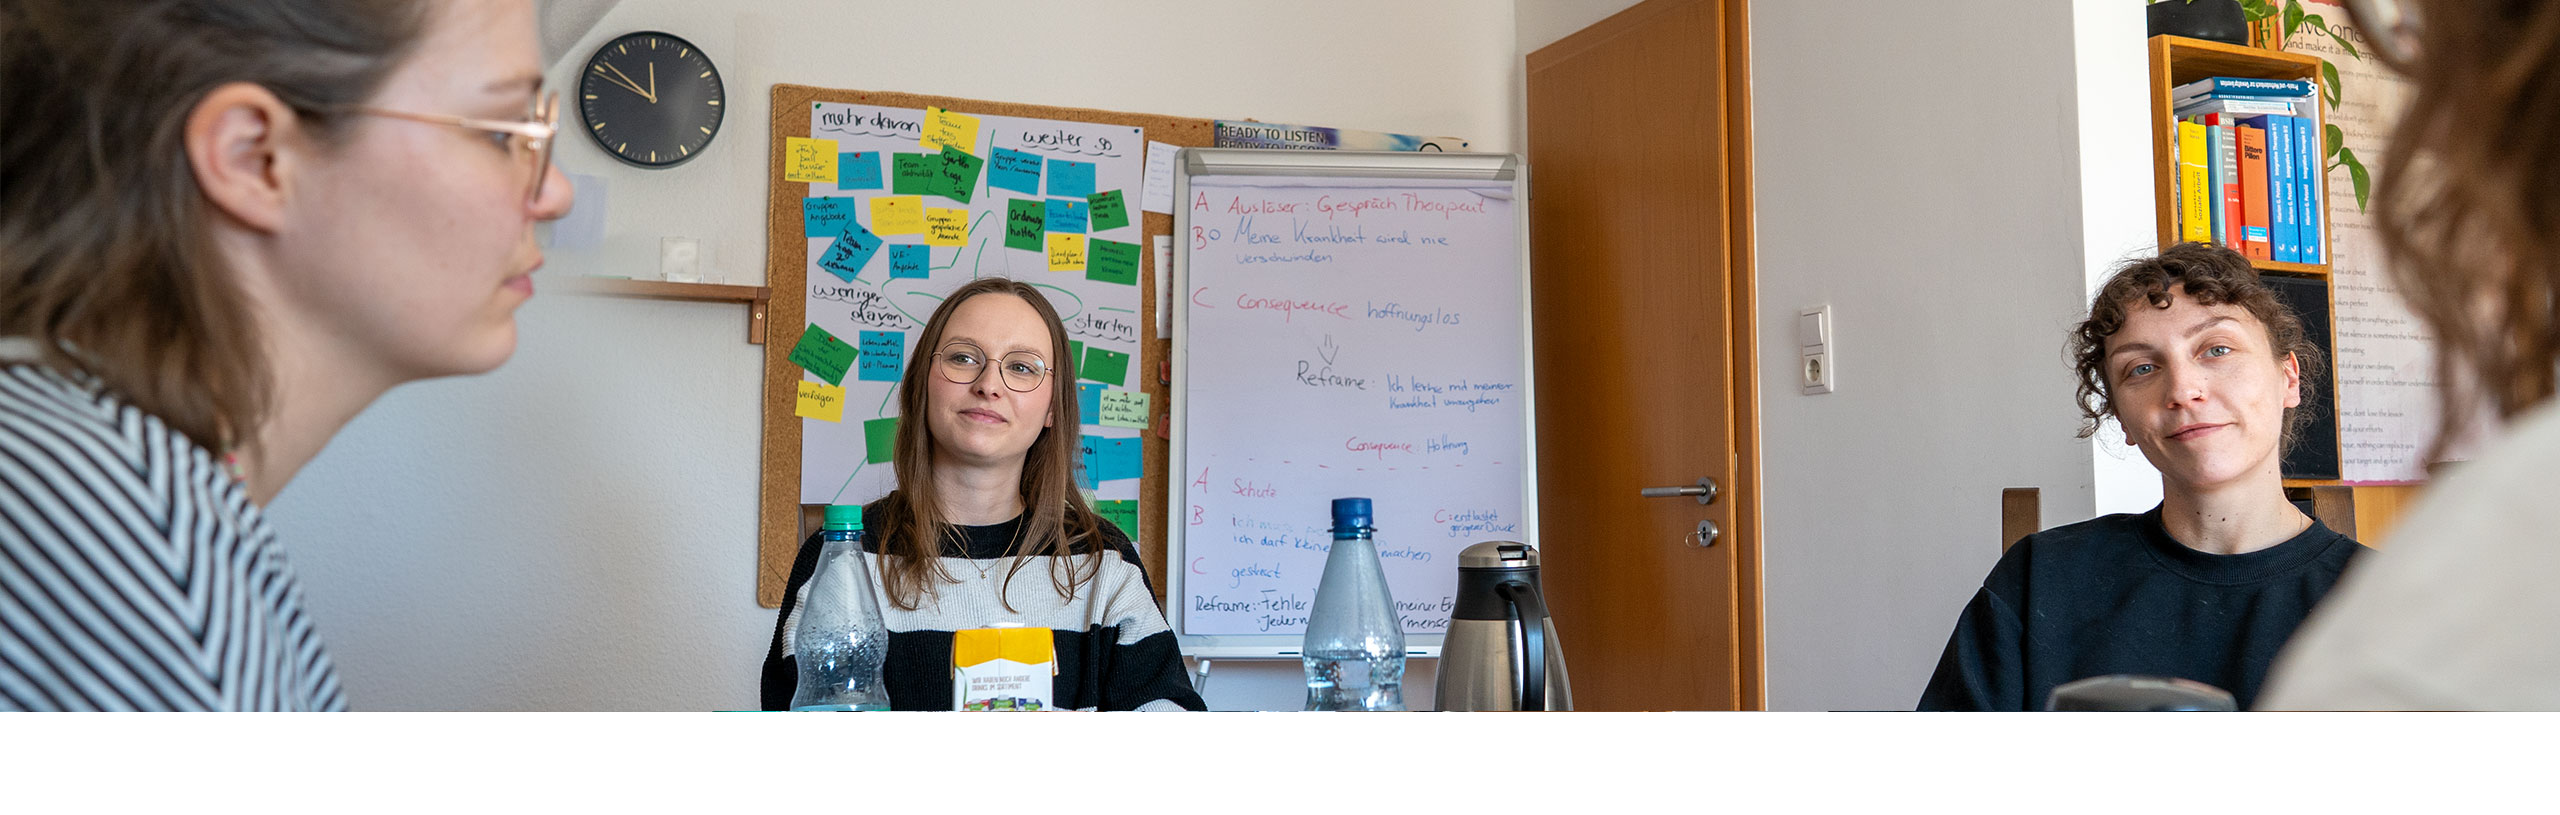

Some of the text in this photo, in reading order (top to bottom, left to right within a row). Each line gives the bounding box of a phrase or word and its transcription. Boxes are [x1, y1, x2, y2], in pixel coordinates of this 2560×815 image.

[822, 108, 921, 134] mehr davon
[1022, 129, 1084, 148] weiter
[1220, 126, 1329, 144] READY TO LISTEN,
[1194, 191, 1210, 213] A
[1317, 194, 1397, 221] Gespräch
[1192, 226, 1207, 250] B
[1233, 215, 1282, 245] Meine
[1293, 216, 1366, 245] Krankheit
[1421, 235, 1449, 246] nie
[813, 284, 883, 311] weniger
[1192, 286, 1215, 309] C
[1367, 300, 1462, 332] hoffnungslos
[851, 305, 904, 326] davon
[1073, 313, 1134, 338] starten
[1387, 373, 1405, 392] Ich
[1449, 379, 1468, 391] mit
[1192, 466, 1277, 498] A Schutz
[1190, 504, 1205, 526] B
[1260, 533, 1288, 547] darf
[1381, 546, 1433, 564] machen
[1192, 556, 1208, 575] C
